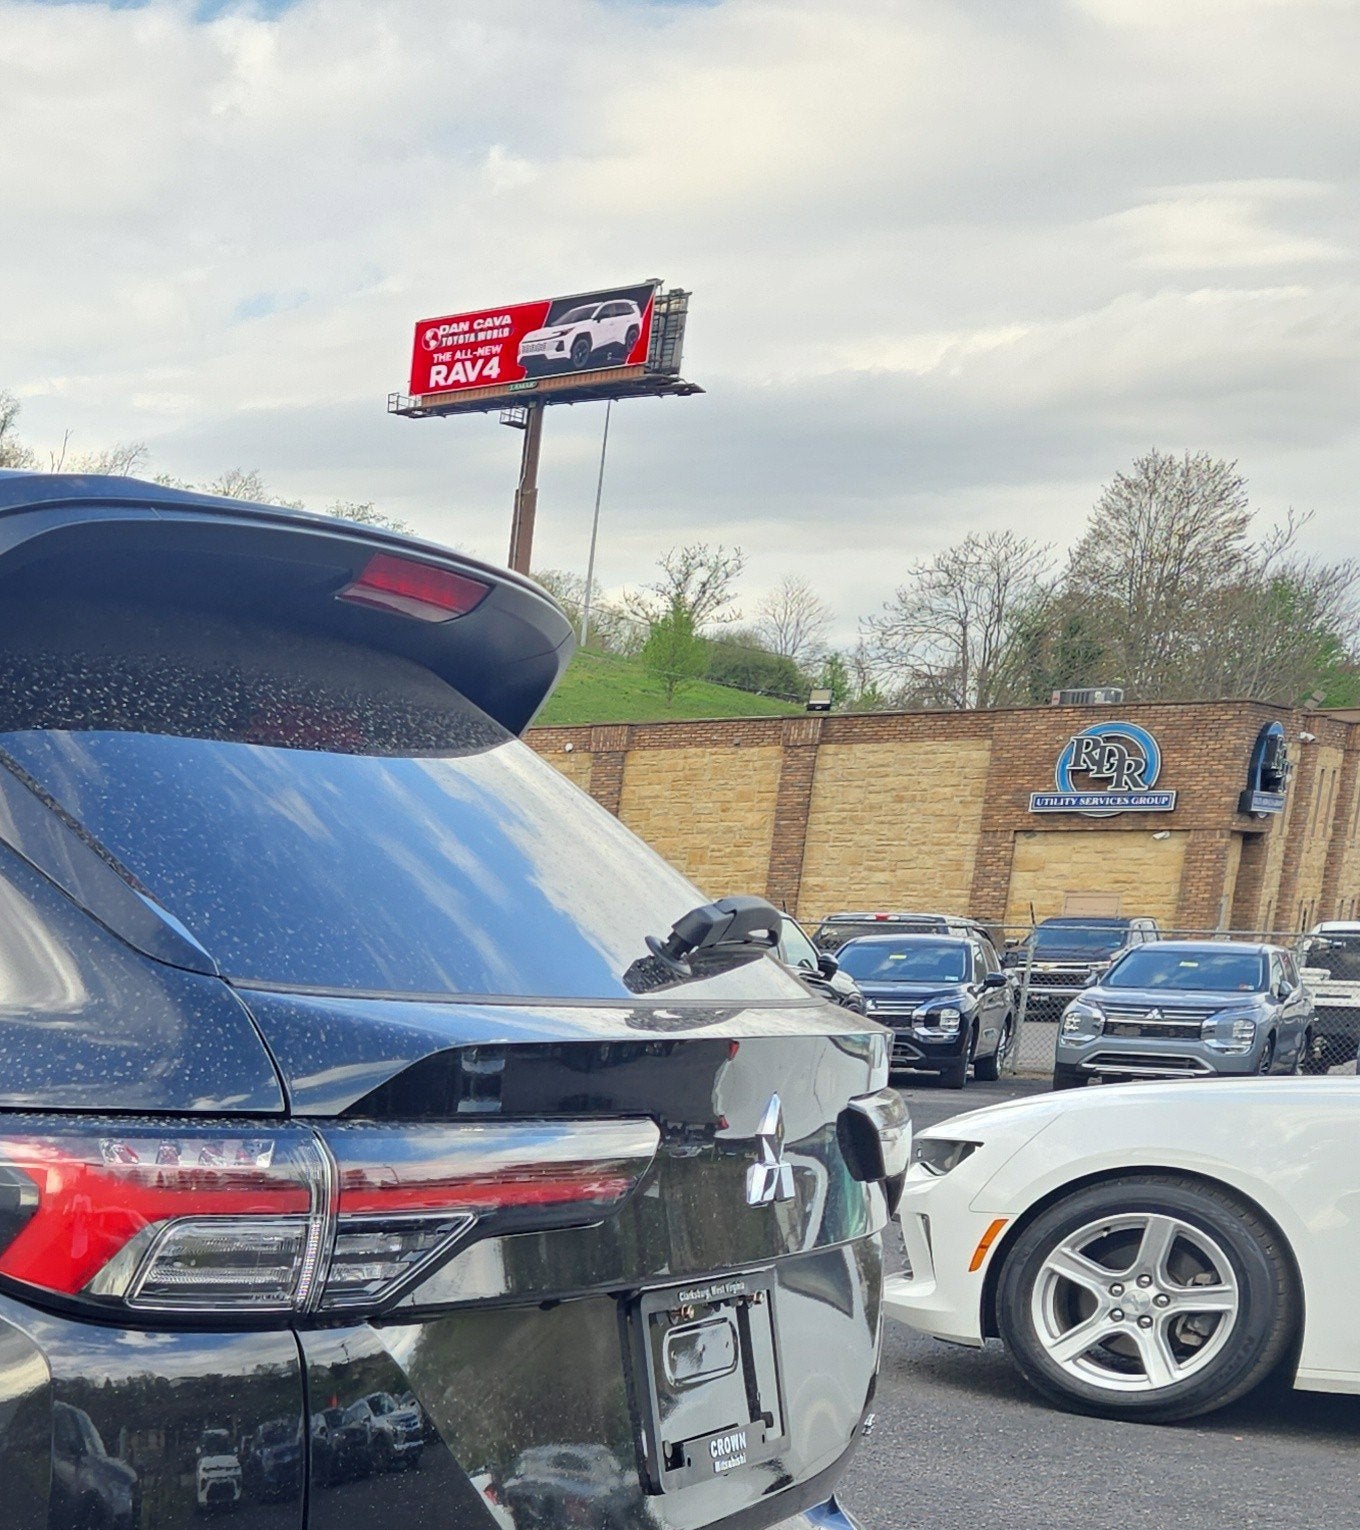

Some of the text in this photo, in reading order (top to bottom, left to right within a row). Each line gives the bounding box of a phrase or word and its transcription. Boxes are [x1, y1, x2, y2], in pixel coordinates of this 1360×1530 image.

[440, 315, 512, 334] DAN CAVA
[442, 332, 475, 347] TOYOTA
[433, 344, 502, 363] THE ALL-NEW
[429, 356, 500, 388] RAV4
[1036, 796, 1169, 806] UTILITY SERVICES GROUP
[710, 1431, 747, 1458] CROWN
